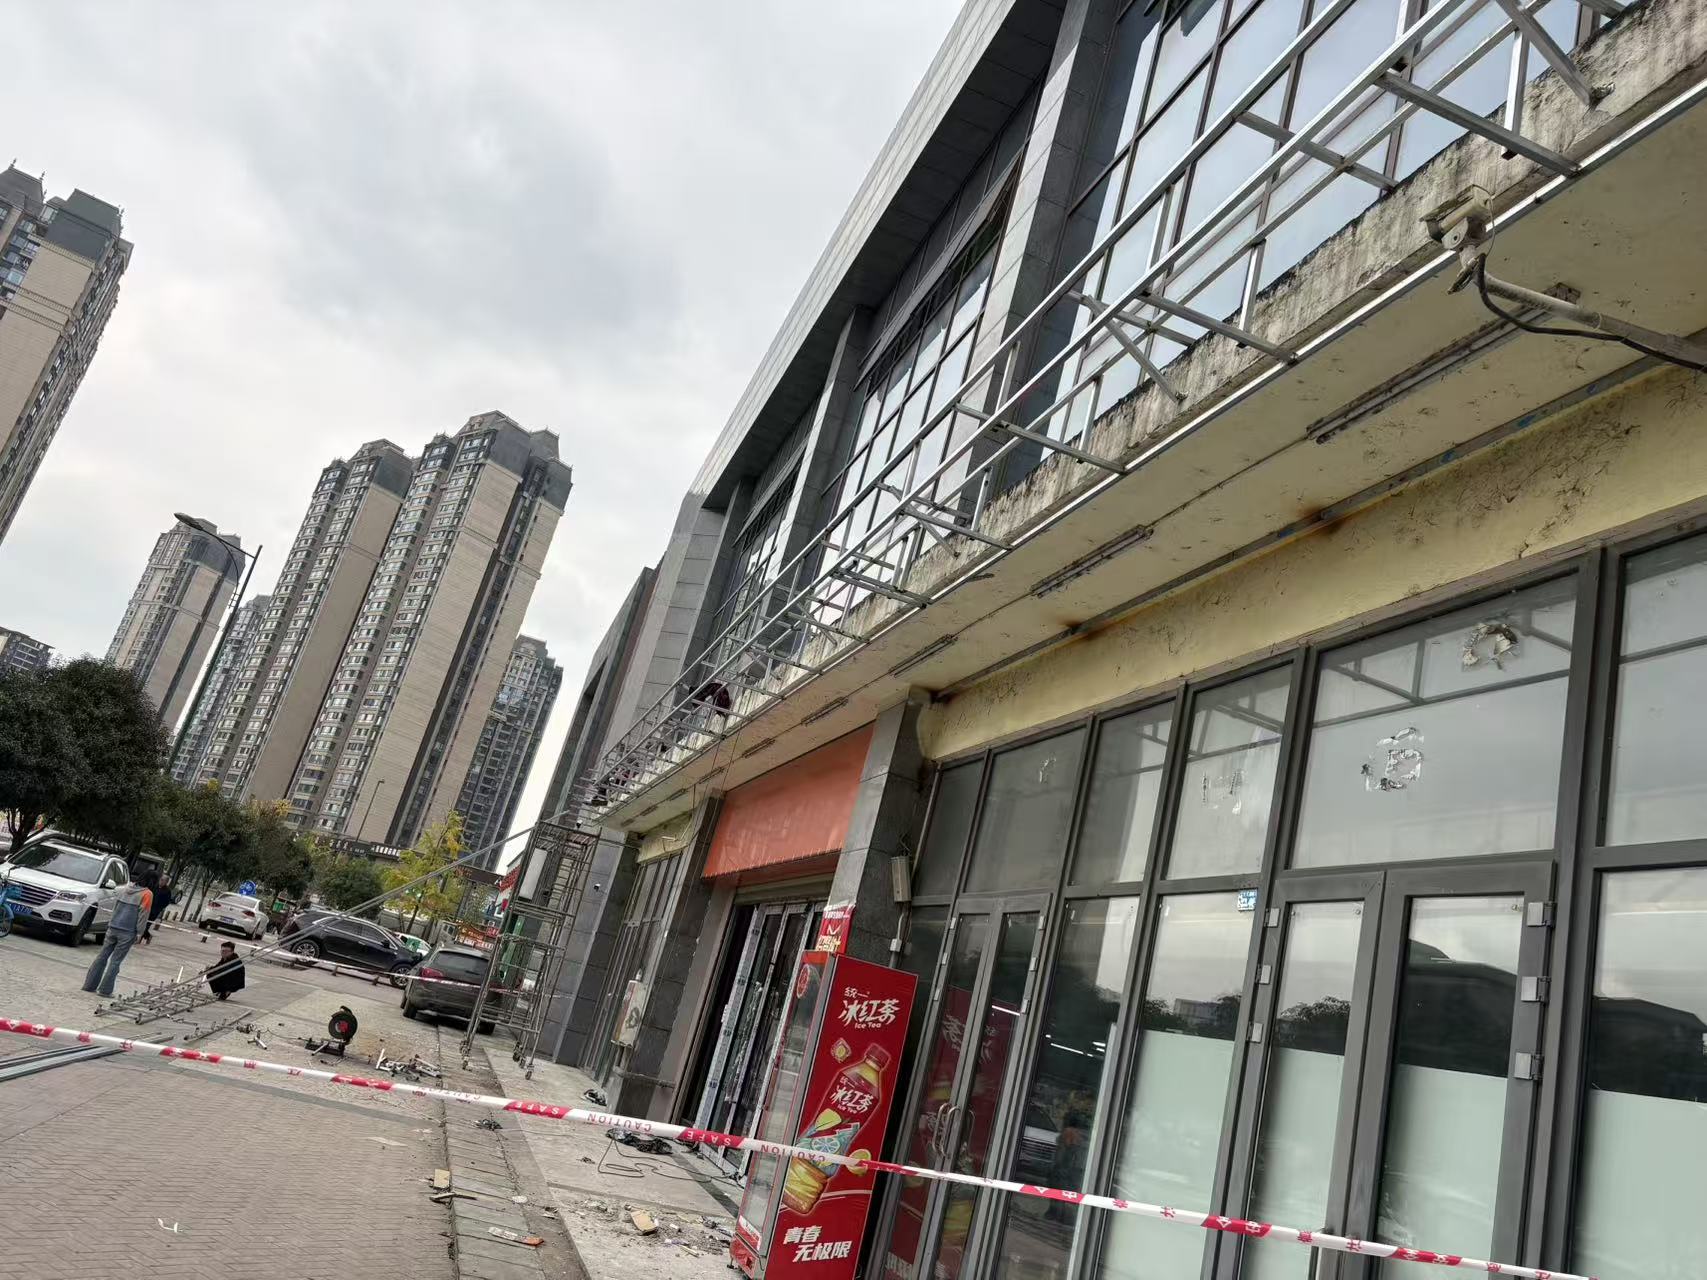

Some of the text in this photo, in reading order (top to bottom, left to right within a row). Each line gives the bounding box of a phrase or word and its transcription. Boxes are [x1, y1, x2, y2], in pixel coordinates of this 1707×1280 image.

[844, 987, 869, 999] 统一
[838, 999, 900, 1027] 冰红茶
[515, 1101, 560, 1115] SAFE
[830, 1085, 874, 1114] 冰红茶
[587, 1113, 651, 1132] CAUTION
[687, 1130, 732, 1147] SAFE
[783, 1225, 822, 1245] 青春
[792, 1241, 852, 1262] 无极限
